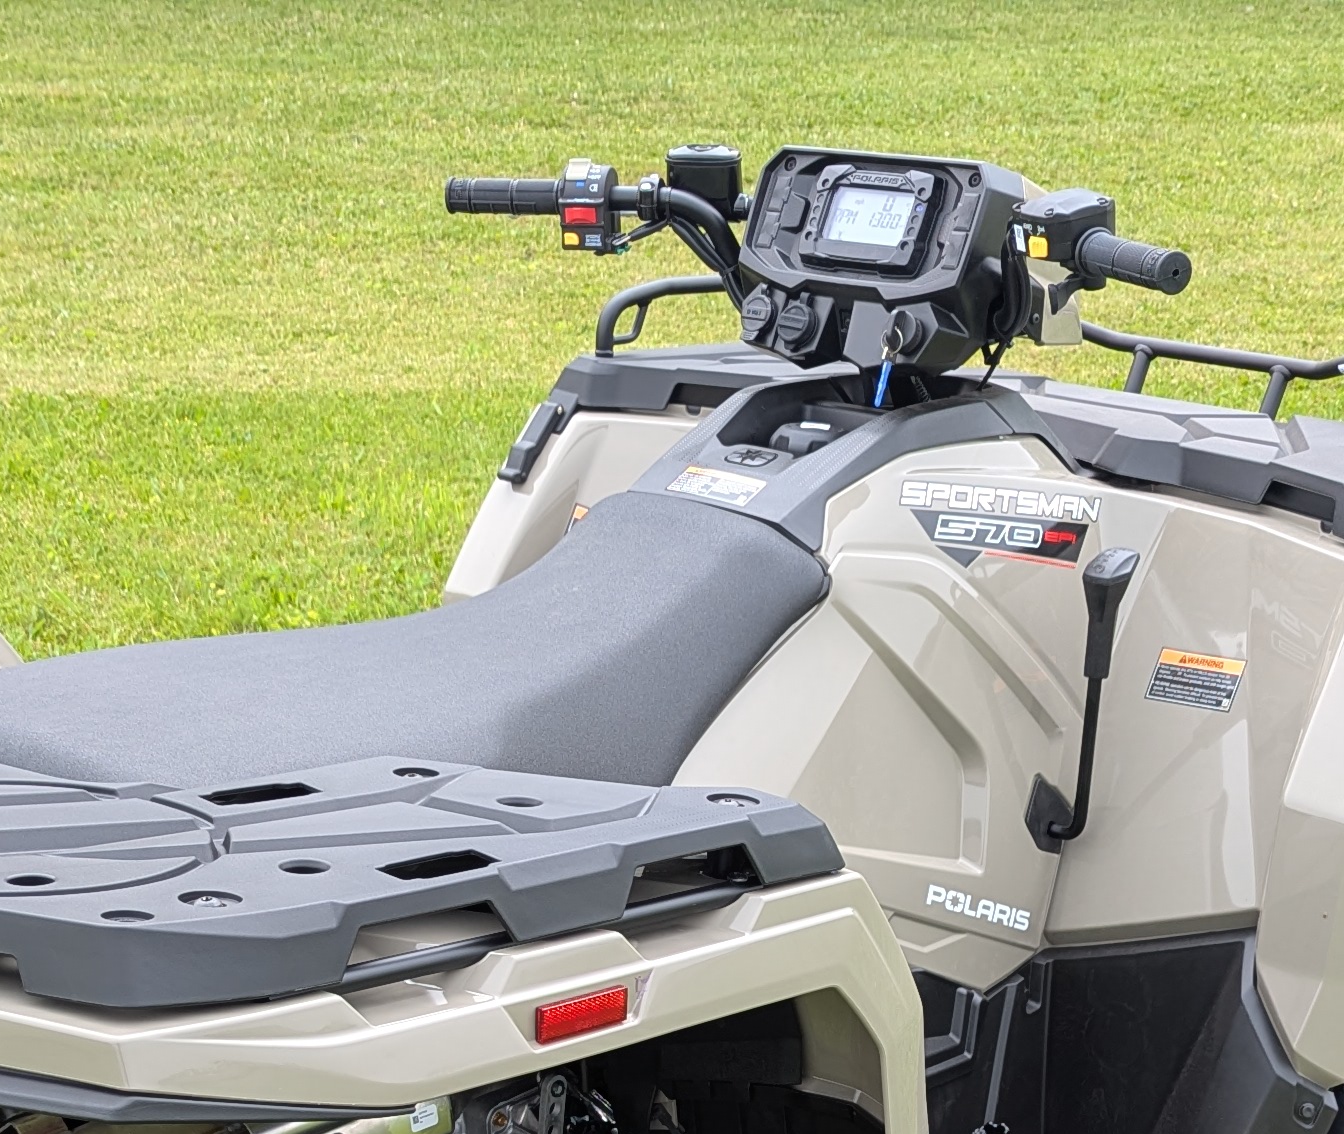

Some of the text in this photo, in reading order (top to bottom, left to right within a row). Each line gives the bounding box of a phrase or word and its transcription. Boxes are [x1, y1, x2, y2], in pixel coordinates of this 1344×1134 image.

[853, 174, 900, 185] POLARIS
[869, 212, 902, 230] 1300
[899, 480, 1102, 523] SPORTSMAN
[934, 514, 1078, 549] 570 EPI
[1187, 655, 1224, 670] WARNING
[926, 884, 1031, 931] POLARIS
